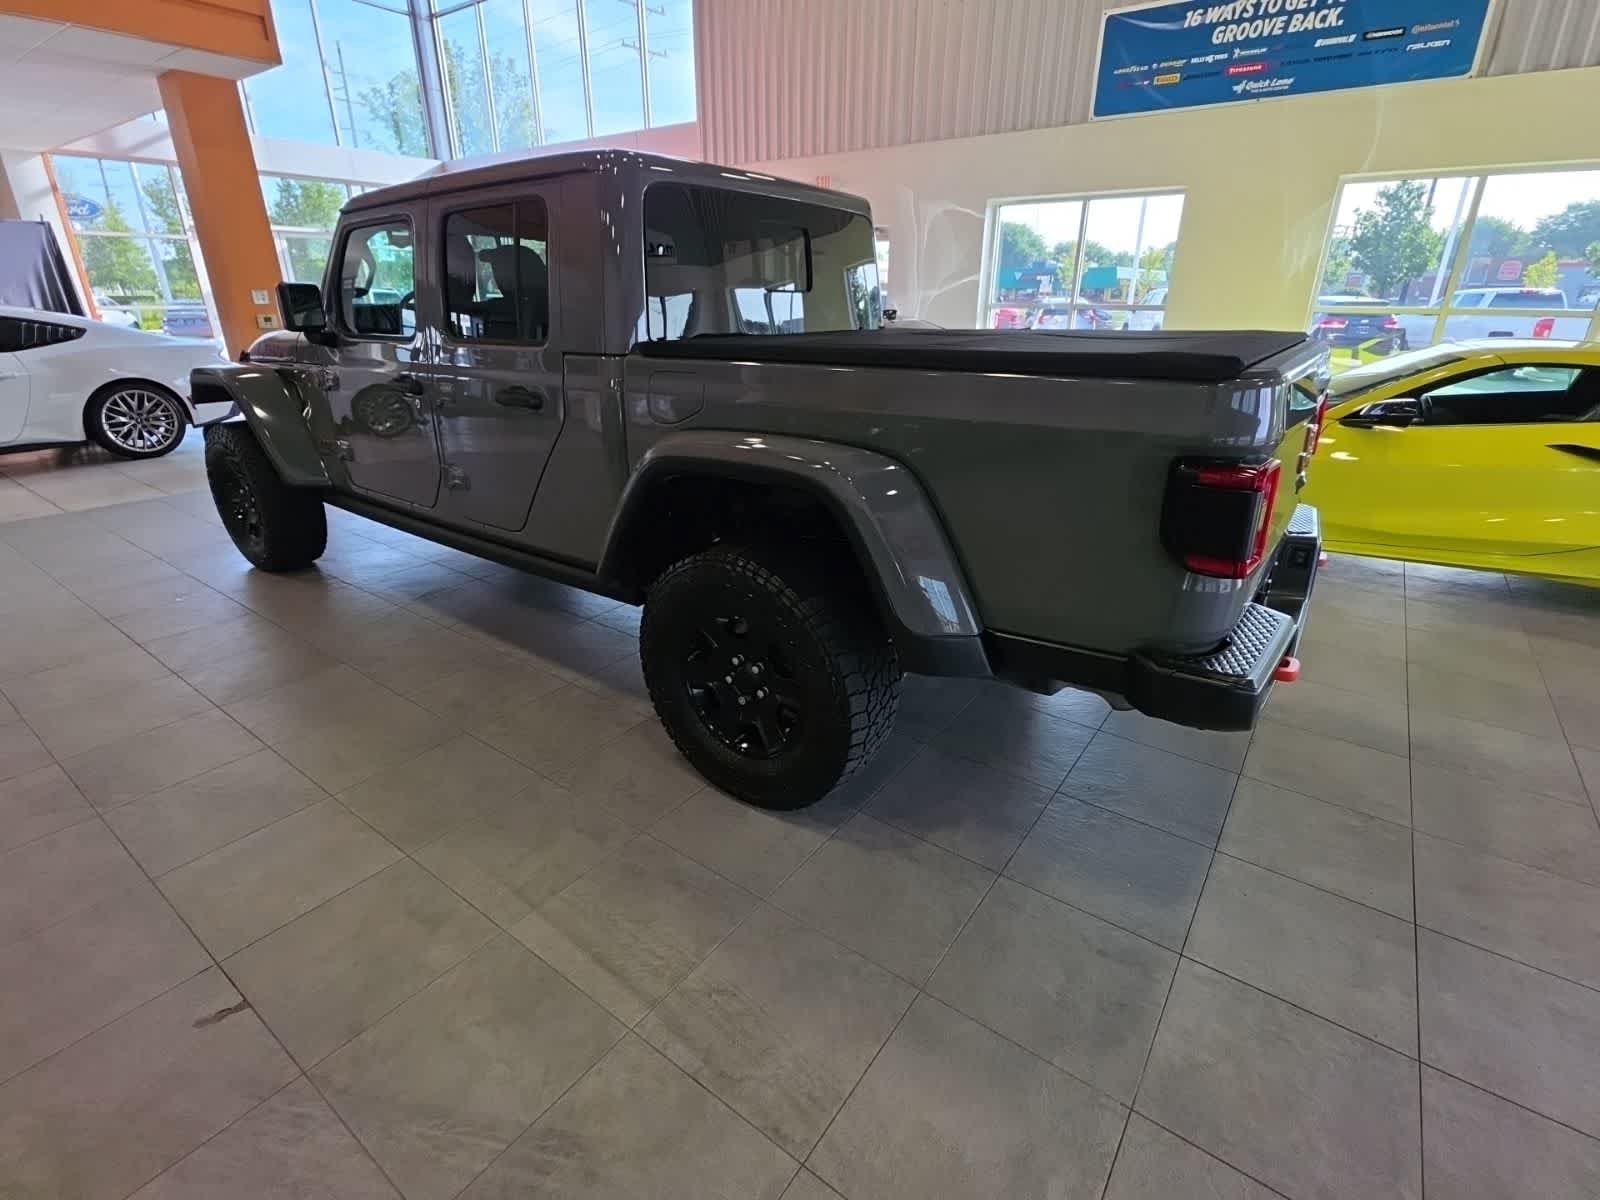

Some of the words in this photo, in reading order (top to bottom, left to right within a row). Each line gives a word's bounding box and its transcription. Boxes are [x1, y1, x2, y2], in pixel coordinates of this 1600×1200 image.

[1183, 9, 1204, 28] 16
[1204, 0, 1258, 24] WAYS
[1258, 0, 1282, 15] TO
[1211, 16, 1288, 45] GROOVE
[1287, 6, 1344, 33] BACK.
[1246, 78, 1271, 91] Quick
[1270, 77, 1296, 88] Lane
